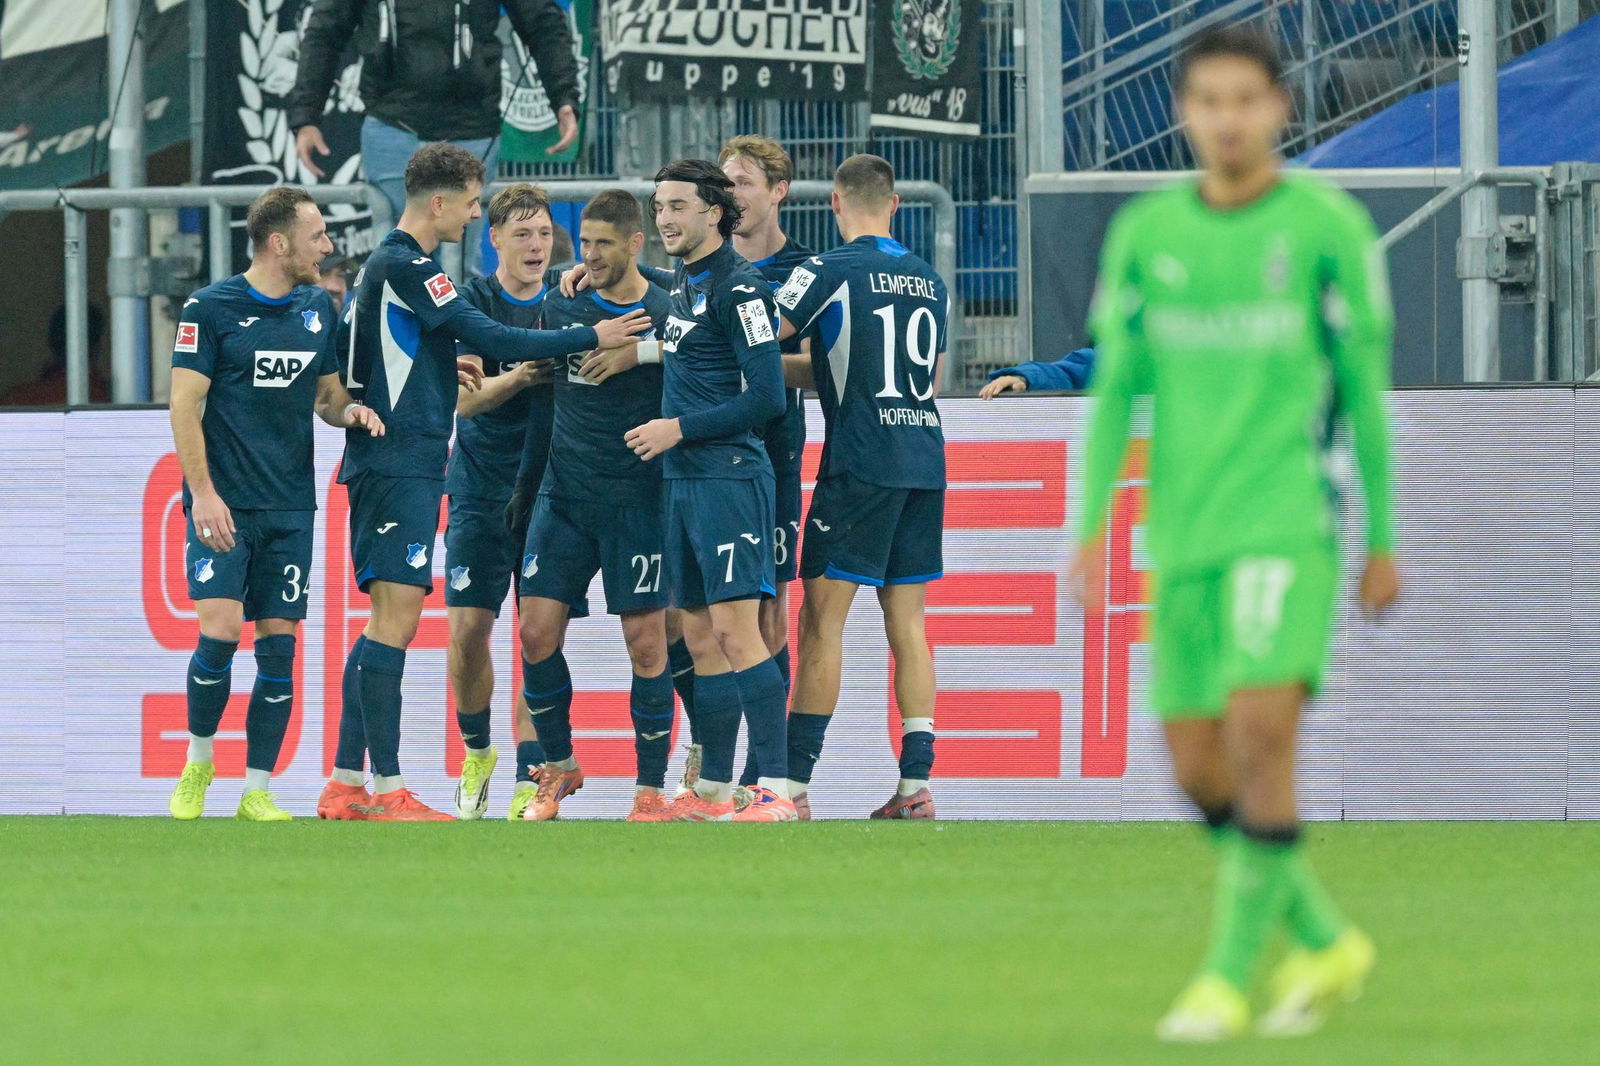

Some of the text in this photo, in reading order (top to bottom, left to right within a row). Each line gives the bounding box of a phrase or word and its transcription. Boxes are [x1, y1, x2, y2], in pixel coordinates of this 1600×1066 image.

[604, 0, 860, 53] ALOCHER
[869, 272, 938, 302] LEMPERLE
[255, 357, 303, 381] SAP
[872, 303, 938, 402] 19
[631, 553, 662, 594] 27
[717, 542, 735, 583] 7
